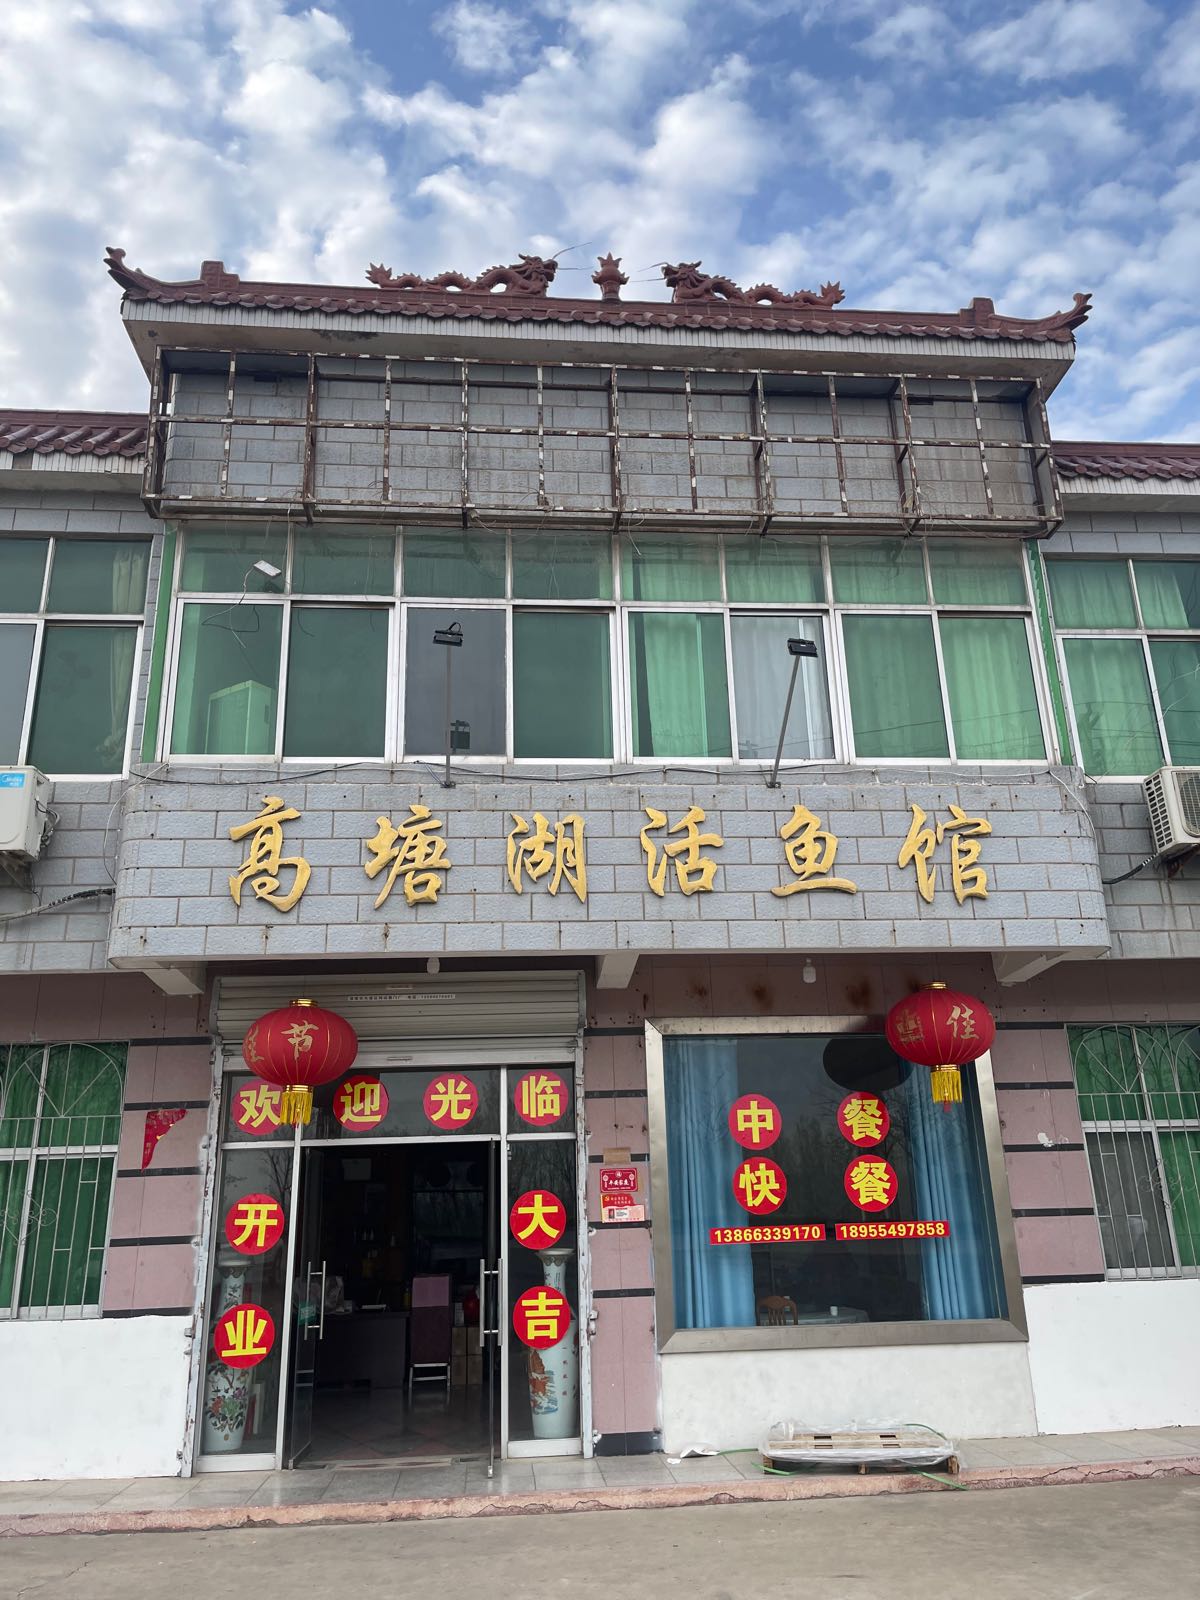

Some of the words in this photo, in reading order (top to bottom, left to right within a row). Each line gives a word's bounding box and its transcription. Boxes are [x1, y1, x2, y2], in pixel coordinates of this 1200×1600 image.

[229, 796, 992, 912] 高塘湖活鱼馆
[239, 1075, 561, 1127] 欢迎光临
[737, 1097, 884, 1143] 中餐
[739, 1160, 892, 1207] 快餐
[714, 1225, 821, 1243] 13866339170
[840, 1222, 946, 1239] 18955497858
[221, 1203, 278, 1358] 开业
[517, 1194, 563, 1340] 大吉
